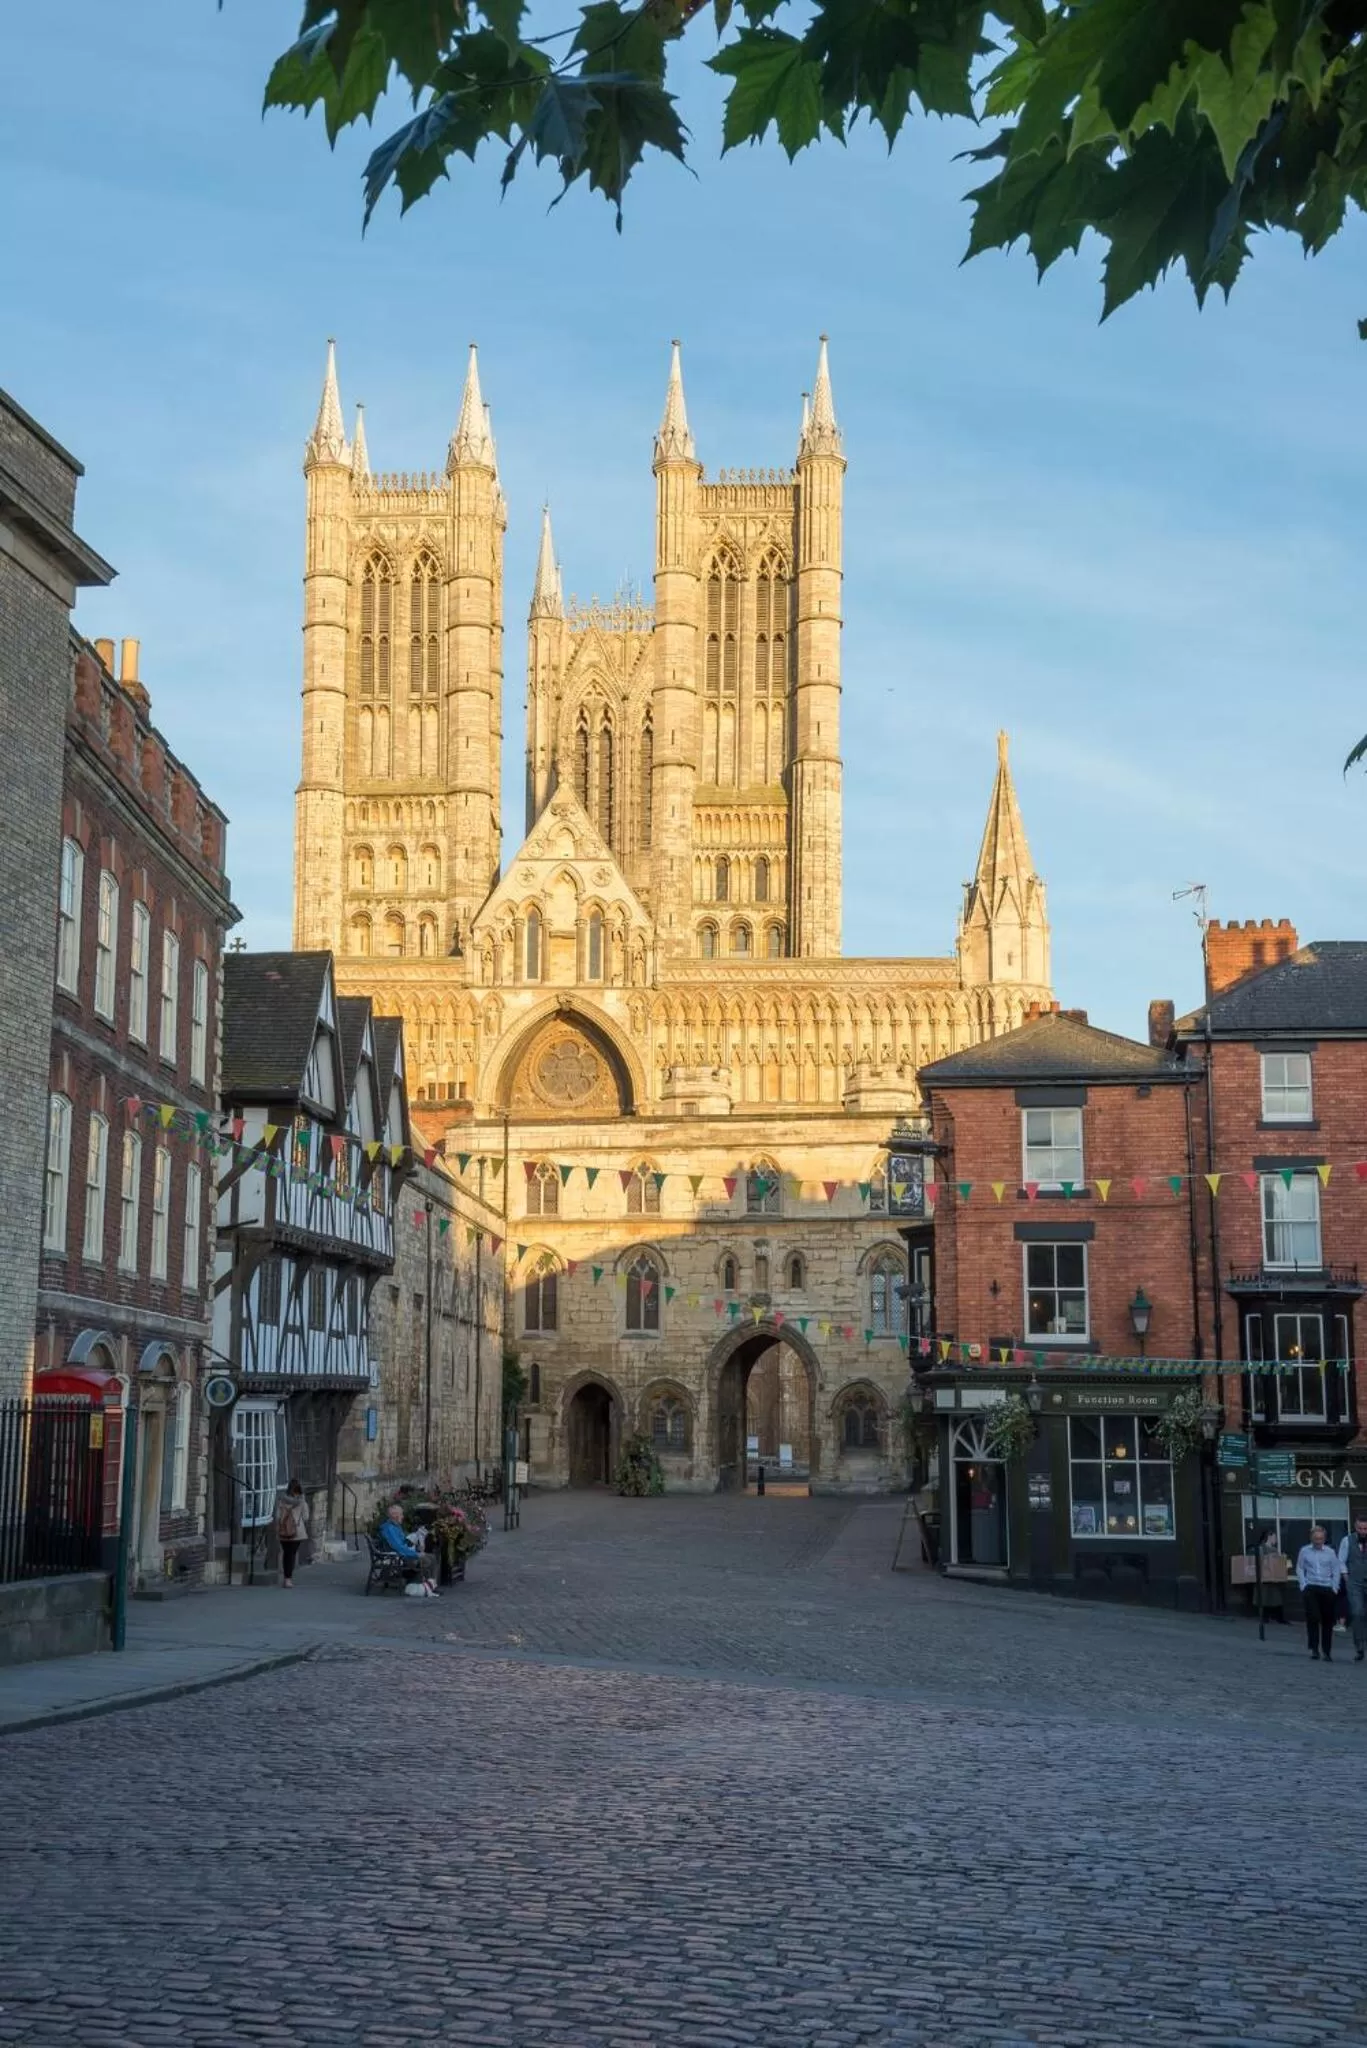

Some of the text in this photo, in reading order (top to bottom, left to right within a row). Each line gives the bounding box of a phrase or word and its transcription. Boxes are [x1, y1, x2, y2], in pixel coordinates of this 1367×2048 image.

[1078, 1394, 1158, 1404] Function Room
[1277, 1467, 1357, 1489] GNA
